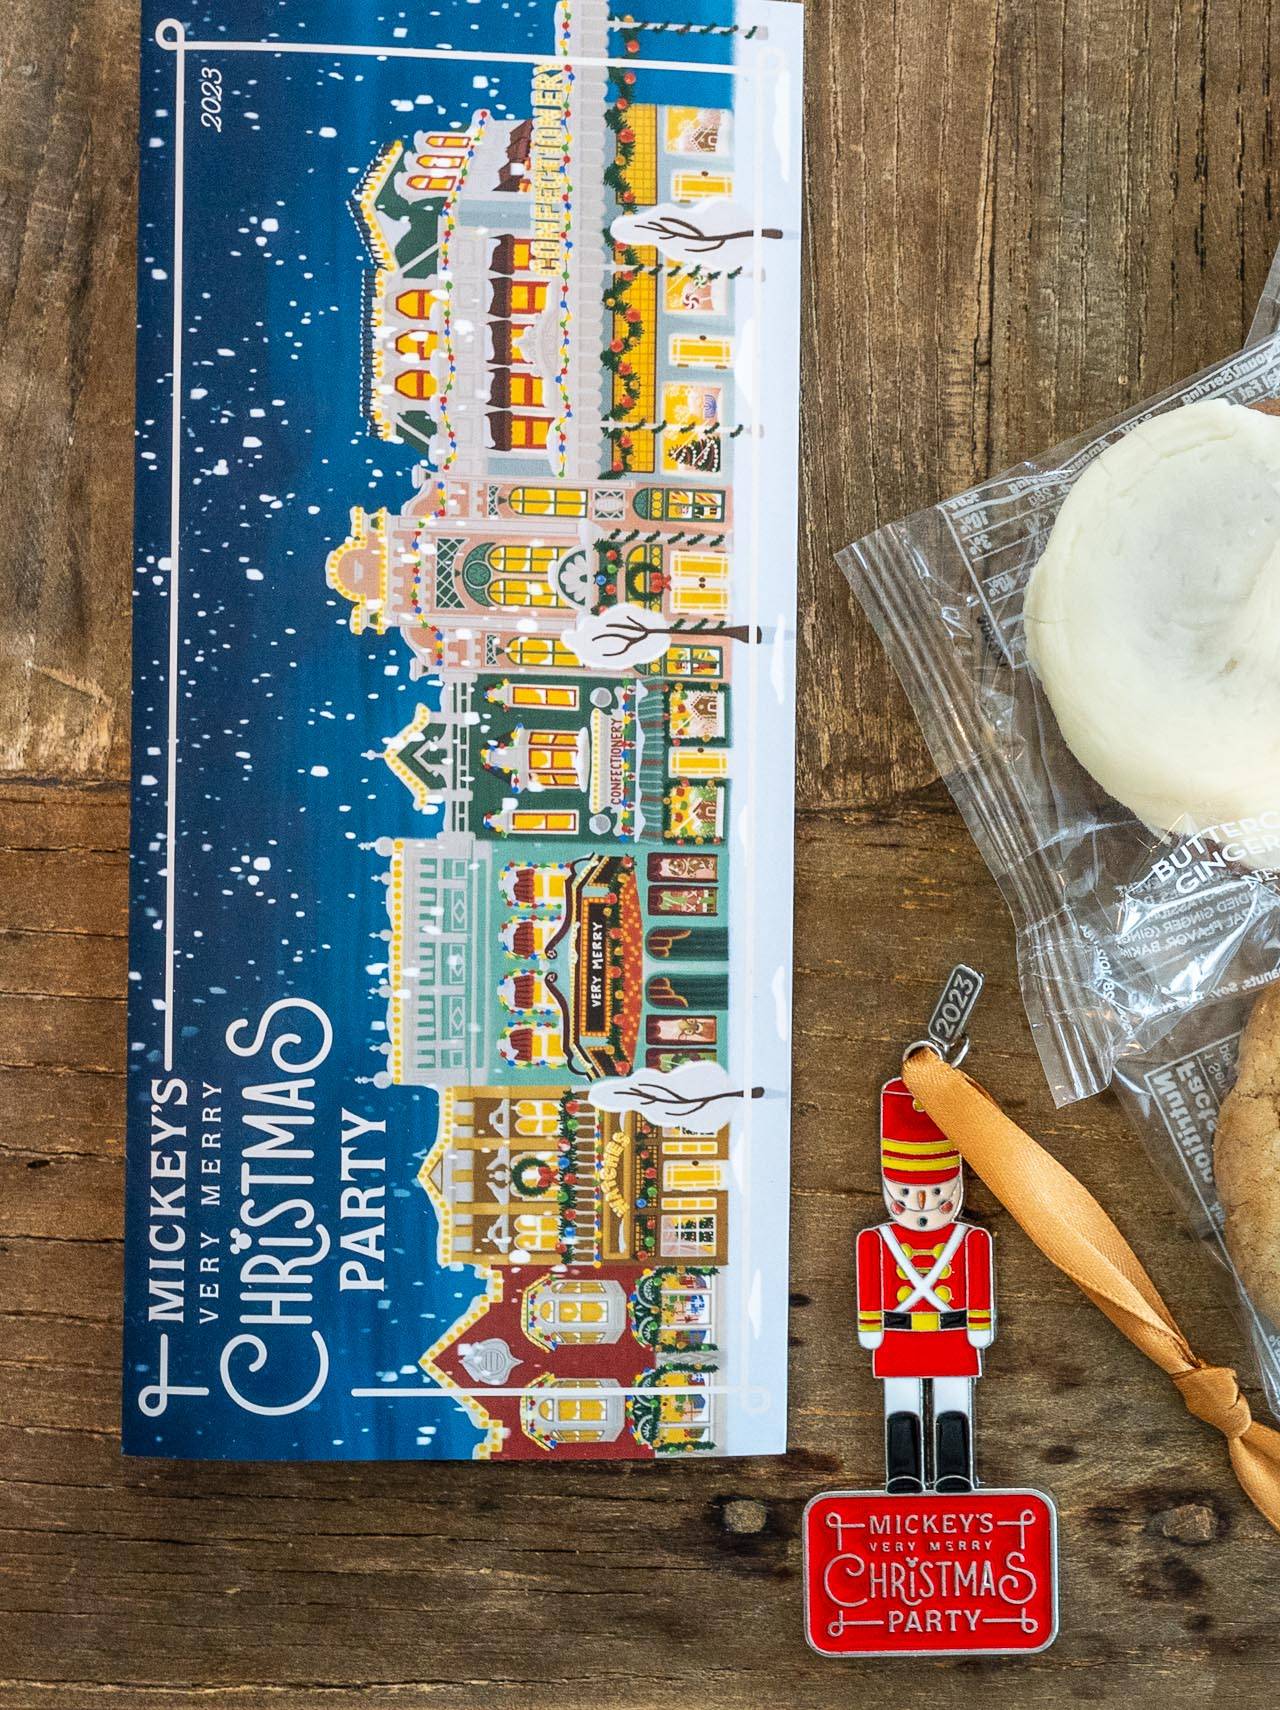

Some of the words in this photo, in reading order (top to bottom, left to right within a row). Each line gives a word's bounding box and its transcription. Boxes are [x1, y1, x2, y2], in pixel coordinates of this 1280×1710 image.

[200, 66, 222, 132] 2023
[610, 718, 625, 806] CONFECTIONERY
[591, 921, 603, 969] MERRY
[591, 975, 601, 1007] VERY
[935, 974, 974, 1039] 2023
[200, 1080, 223, 1207] MERRY
[148, 1077, 189, 1323] MICKEY'S
[338, 1106, 387, 1292] PARTY
[199, 1231, 222, 1324] VERY
[869, 1513, 994, 1535] MICKEY'S
[869, 1541, 916, 1552] VERY
[929, 1540, 993, 1551] MERRY
[888, 1609, 982, 1633] PARTY
